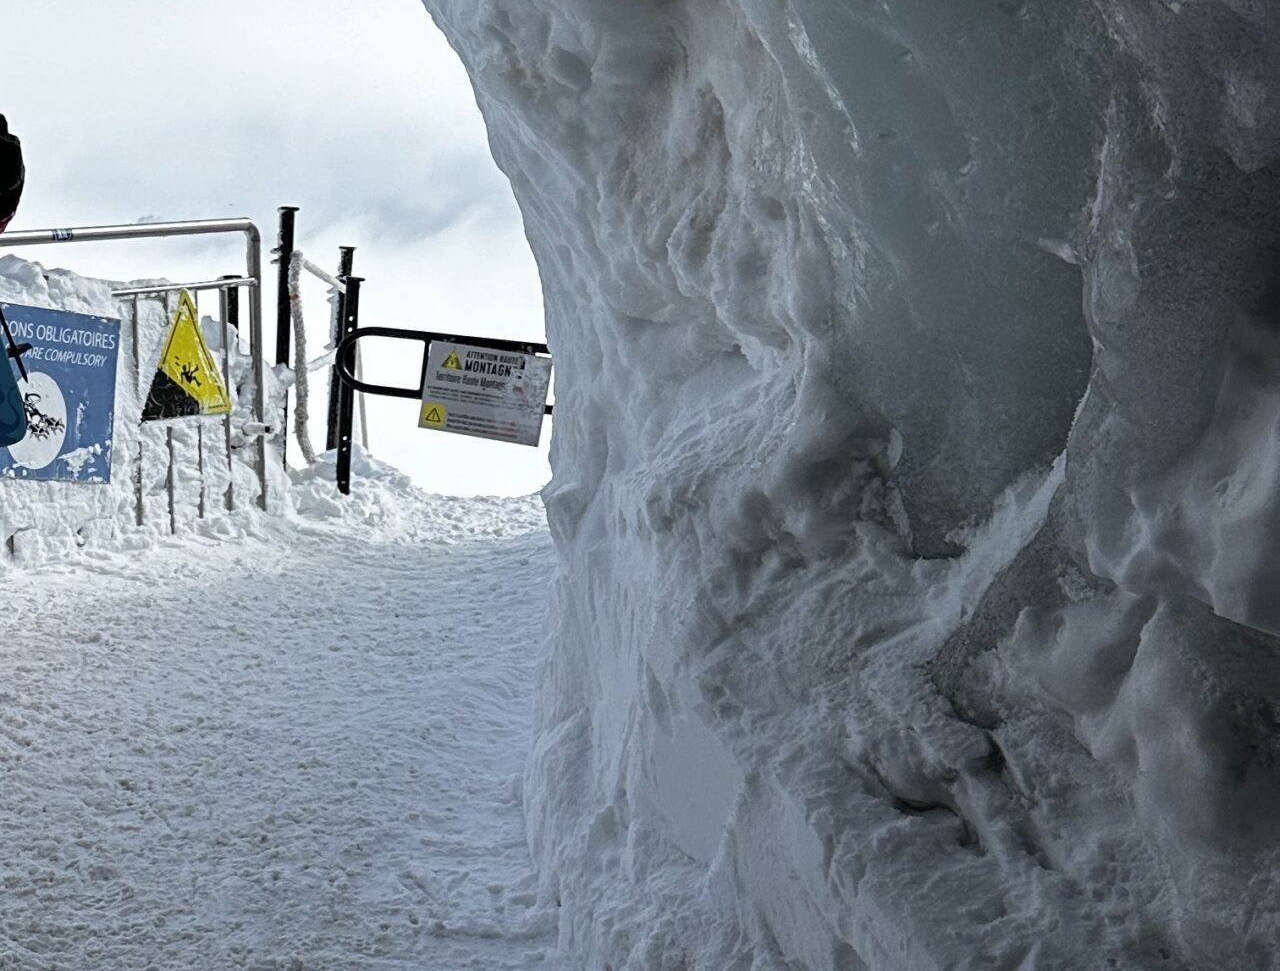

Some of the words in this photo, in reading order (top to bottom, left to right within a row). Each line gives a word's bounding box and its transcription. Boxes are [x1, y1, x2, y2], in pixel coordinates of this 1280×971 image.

[36, 324, 116, 350] OBLIGATOIRES
[25, 346, 43, 360] ARE
[44, 348, 107, 367] COMPULSORY
[466, 350, 498, 362] ATTENTION
